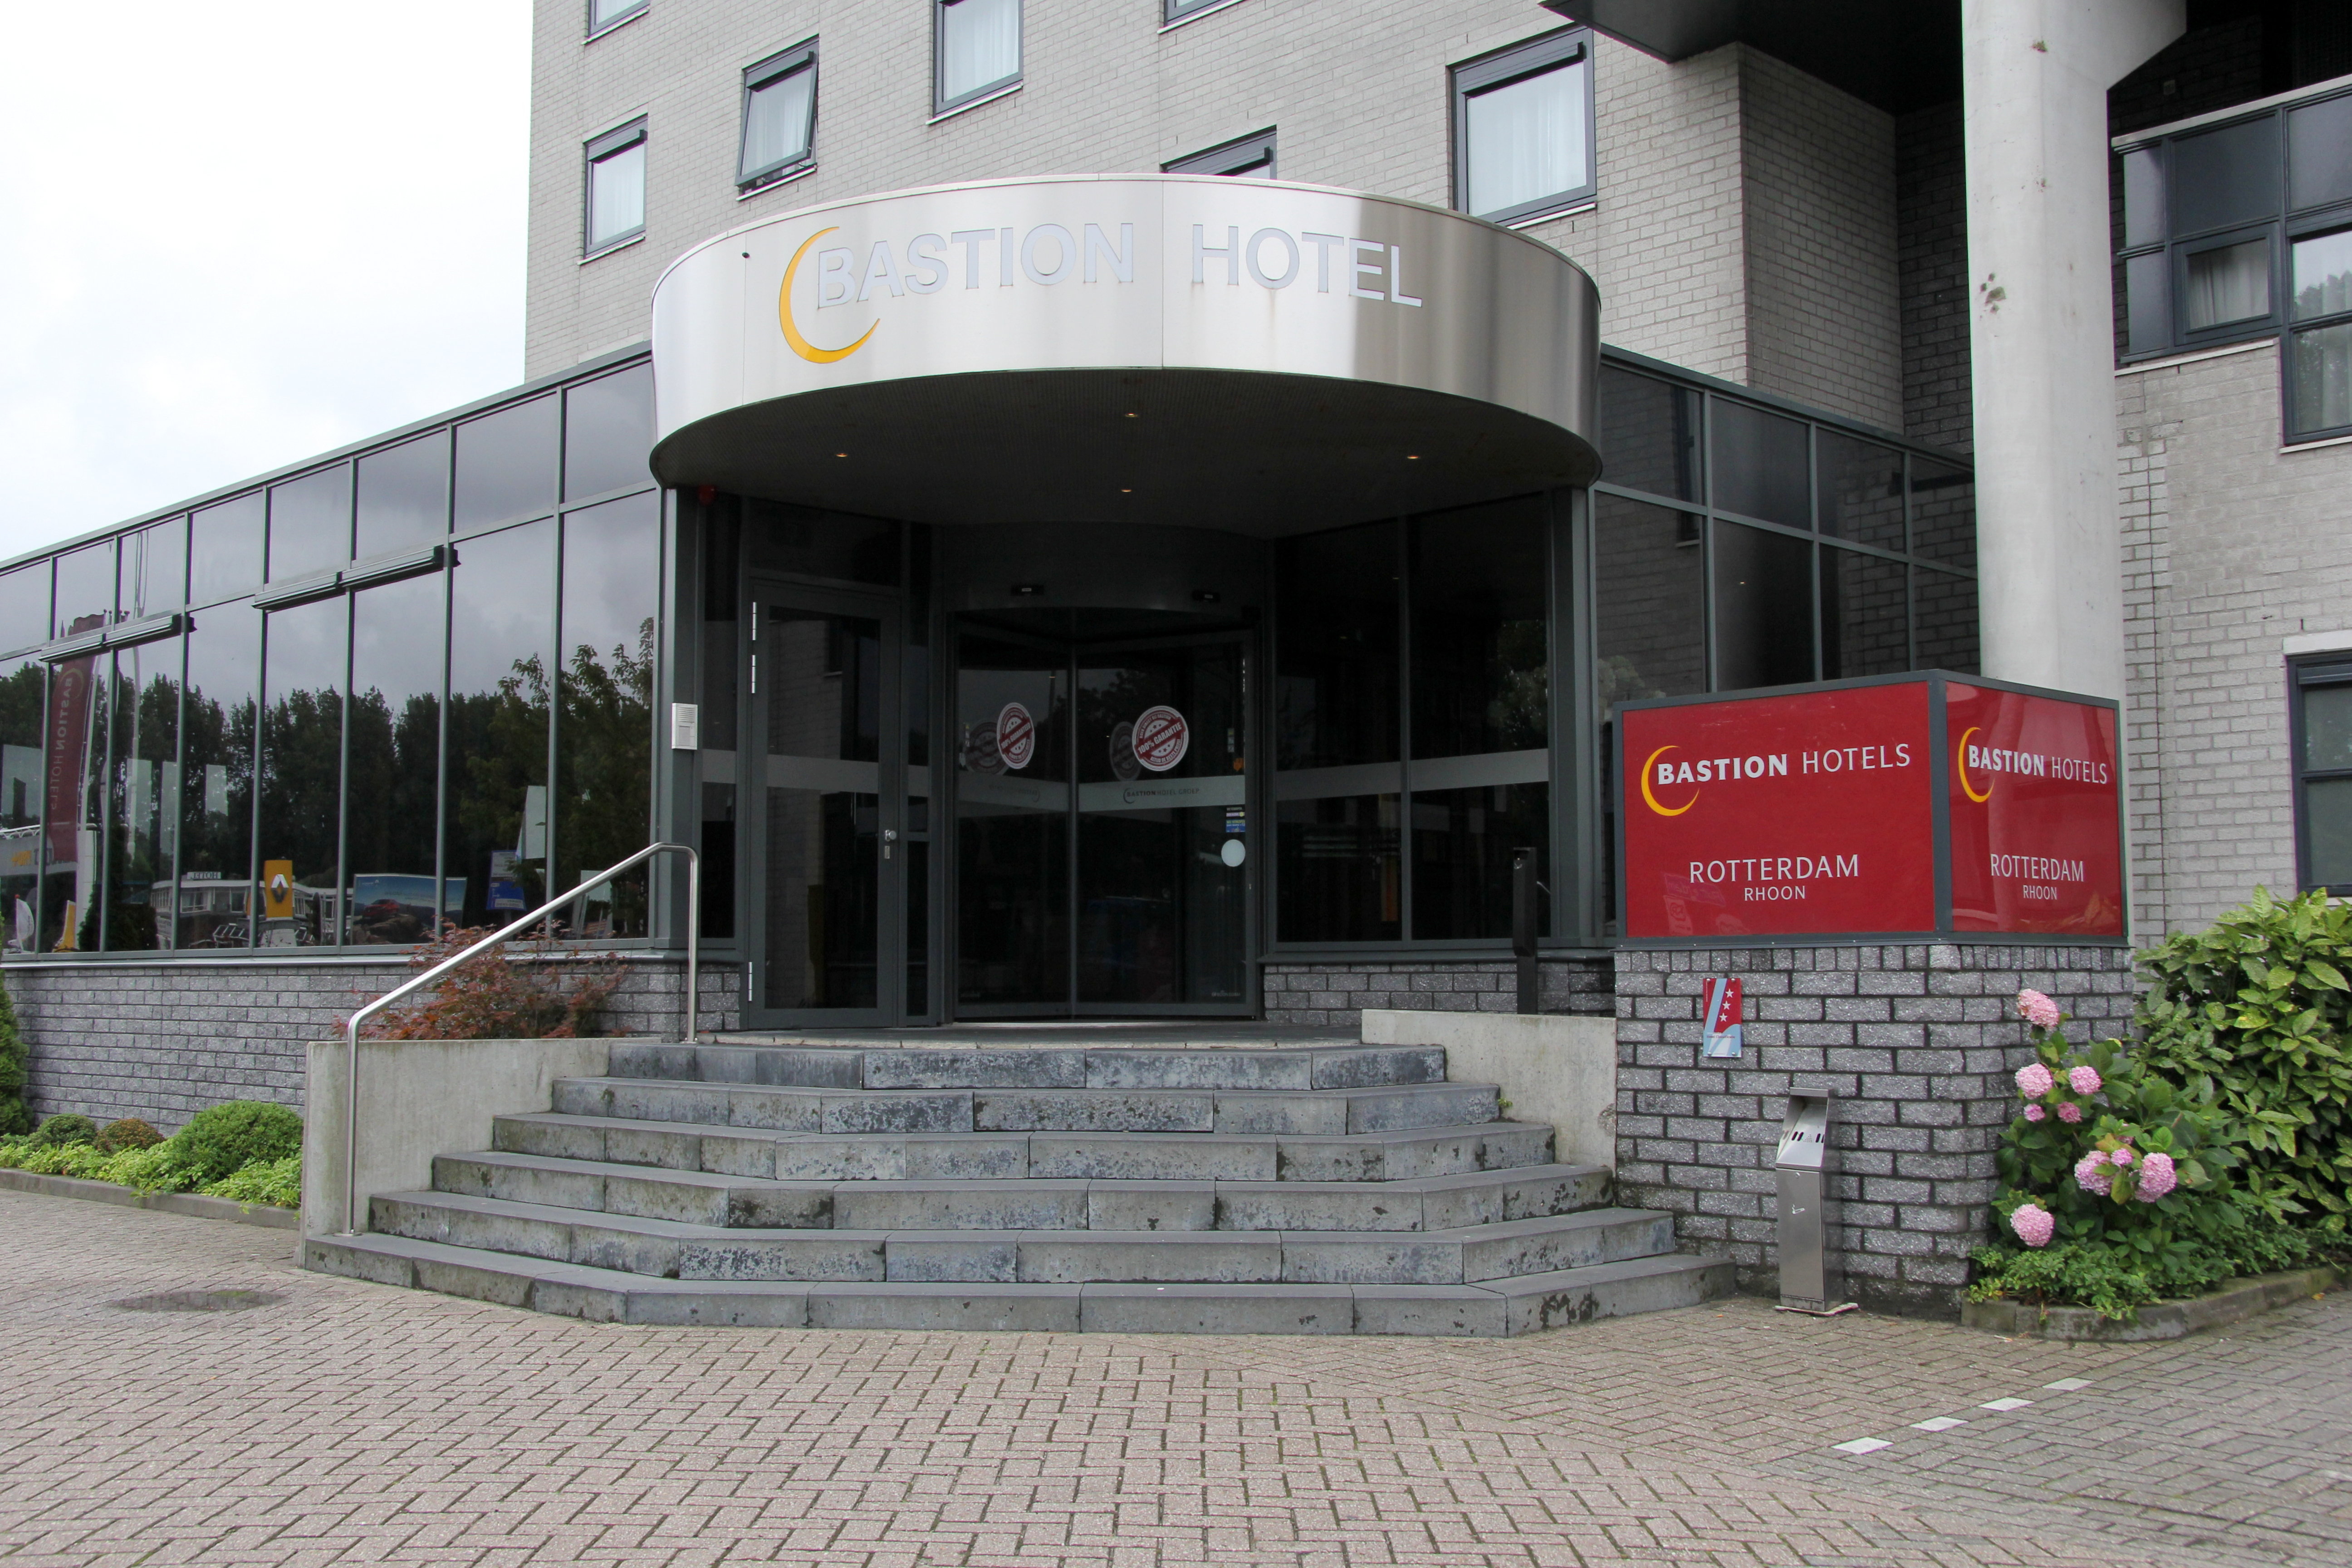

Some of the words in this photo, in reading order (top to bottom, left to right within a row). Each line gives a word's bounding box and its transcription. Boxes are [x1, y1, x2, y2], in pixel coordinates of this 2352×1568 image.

[818, 223, 1134, 309] BASTION
[1191, 224, 1423, 309] HOTEL
[1137, 740, 1155, 754] 100%
[1153, 722, 1182, 745] GARANTIE
[1658, 754, 1787, 785] BASTION
[1803, 743, 1910, 774] HOTELS
[1969, 745, 2044, 776] BASTION
[2052, 757, 2107, 784] HOTELS
[1690, 854, 1859, 883] ROTTERDAM
[1990, 854, 2084, 882] ROTTERDAM
[1744, 885, 1806, 901] RHOON
[2022, 885, 2057, 900] RHOON
